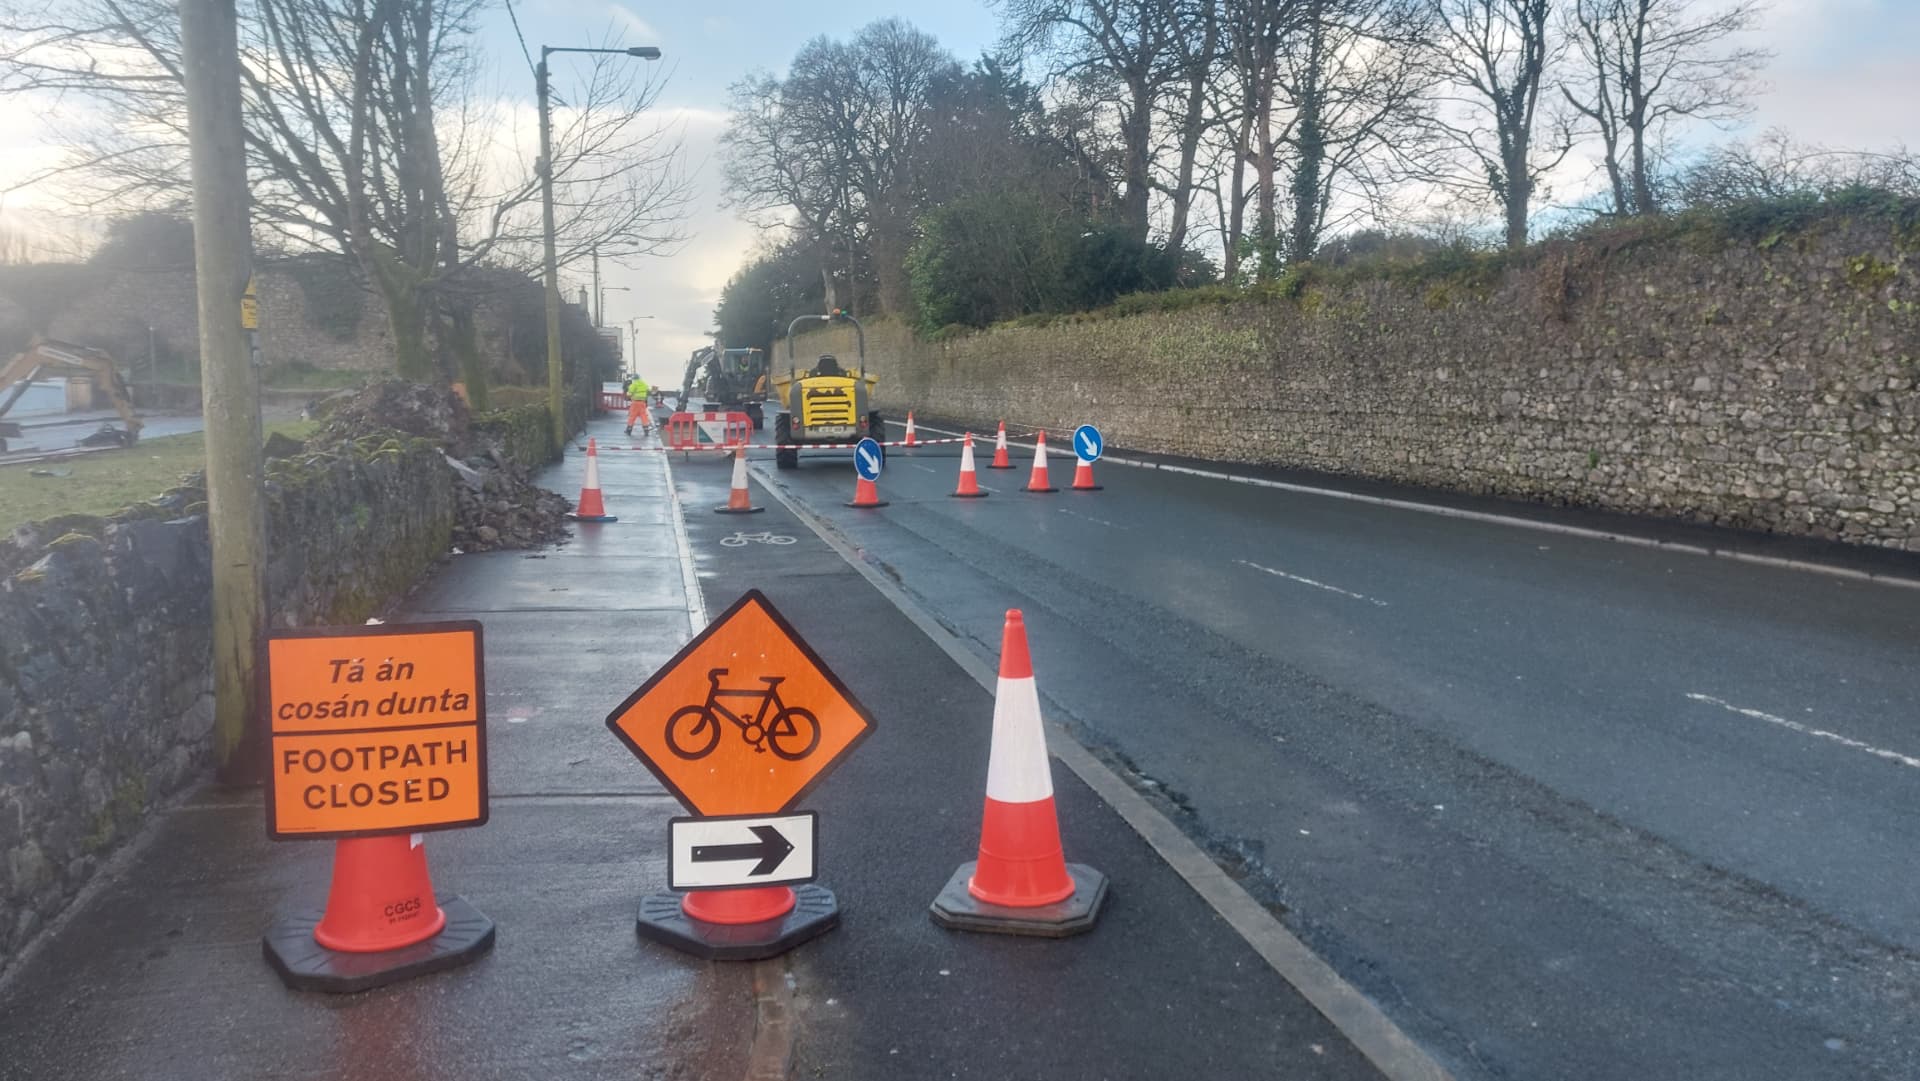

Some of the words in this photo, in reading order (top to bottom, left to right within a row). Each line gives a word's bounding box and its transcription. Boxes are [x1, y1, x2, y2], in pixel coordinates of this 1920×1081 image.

[329, 657, 365, 684] Tá
[277, 693, 370, 721] cosán
[376, 687, 470, 717] dunta
[283, 739, 468, 775] FOOTPATH
[303, 776, 450, 810] CLOSED
[384, 898, 421, 917] CGCS
